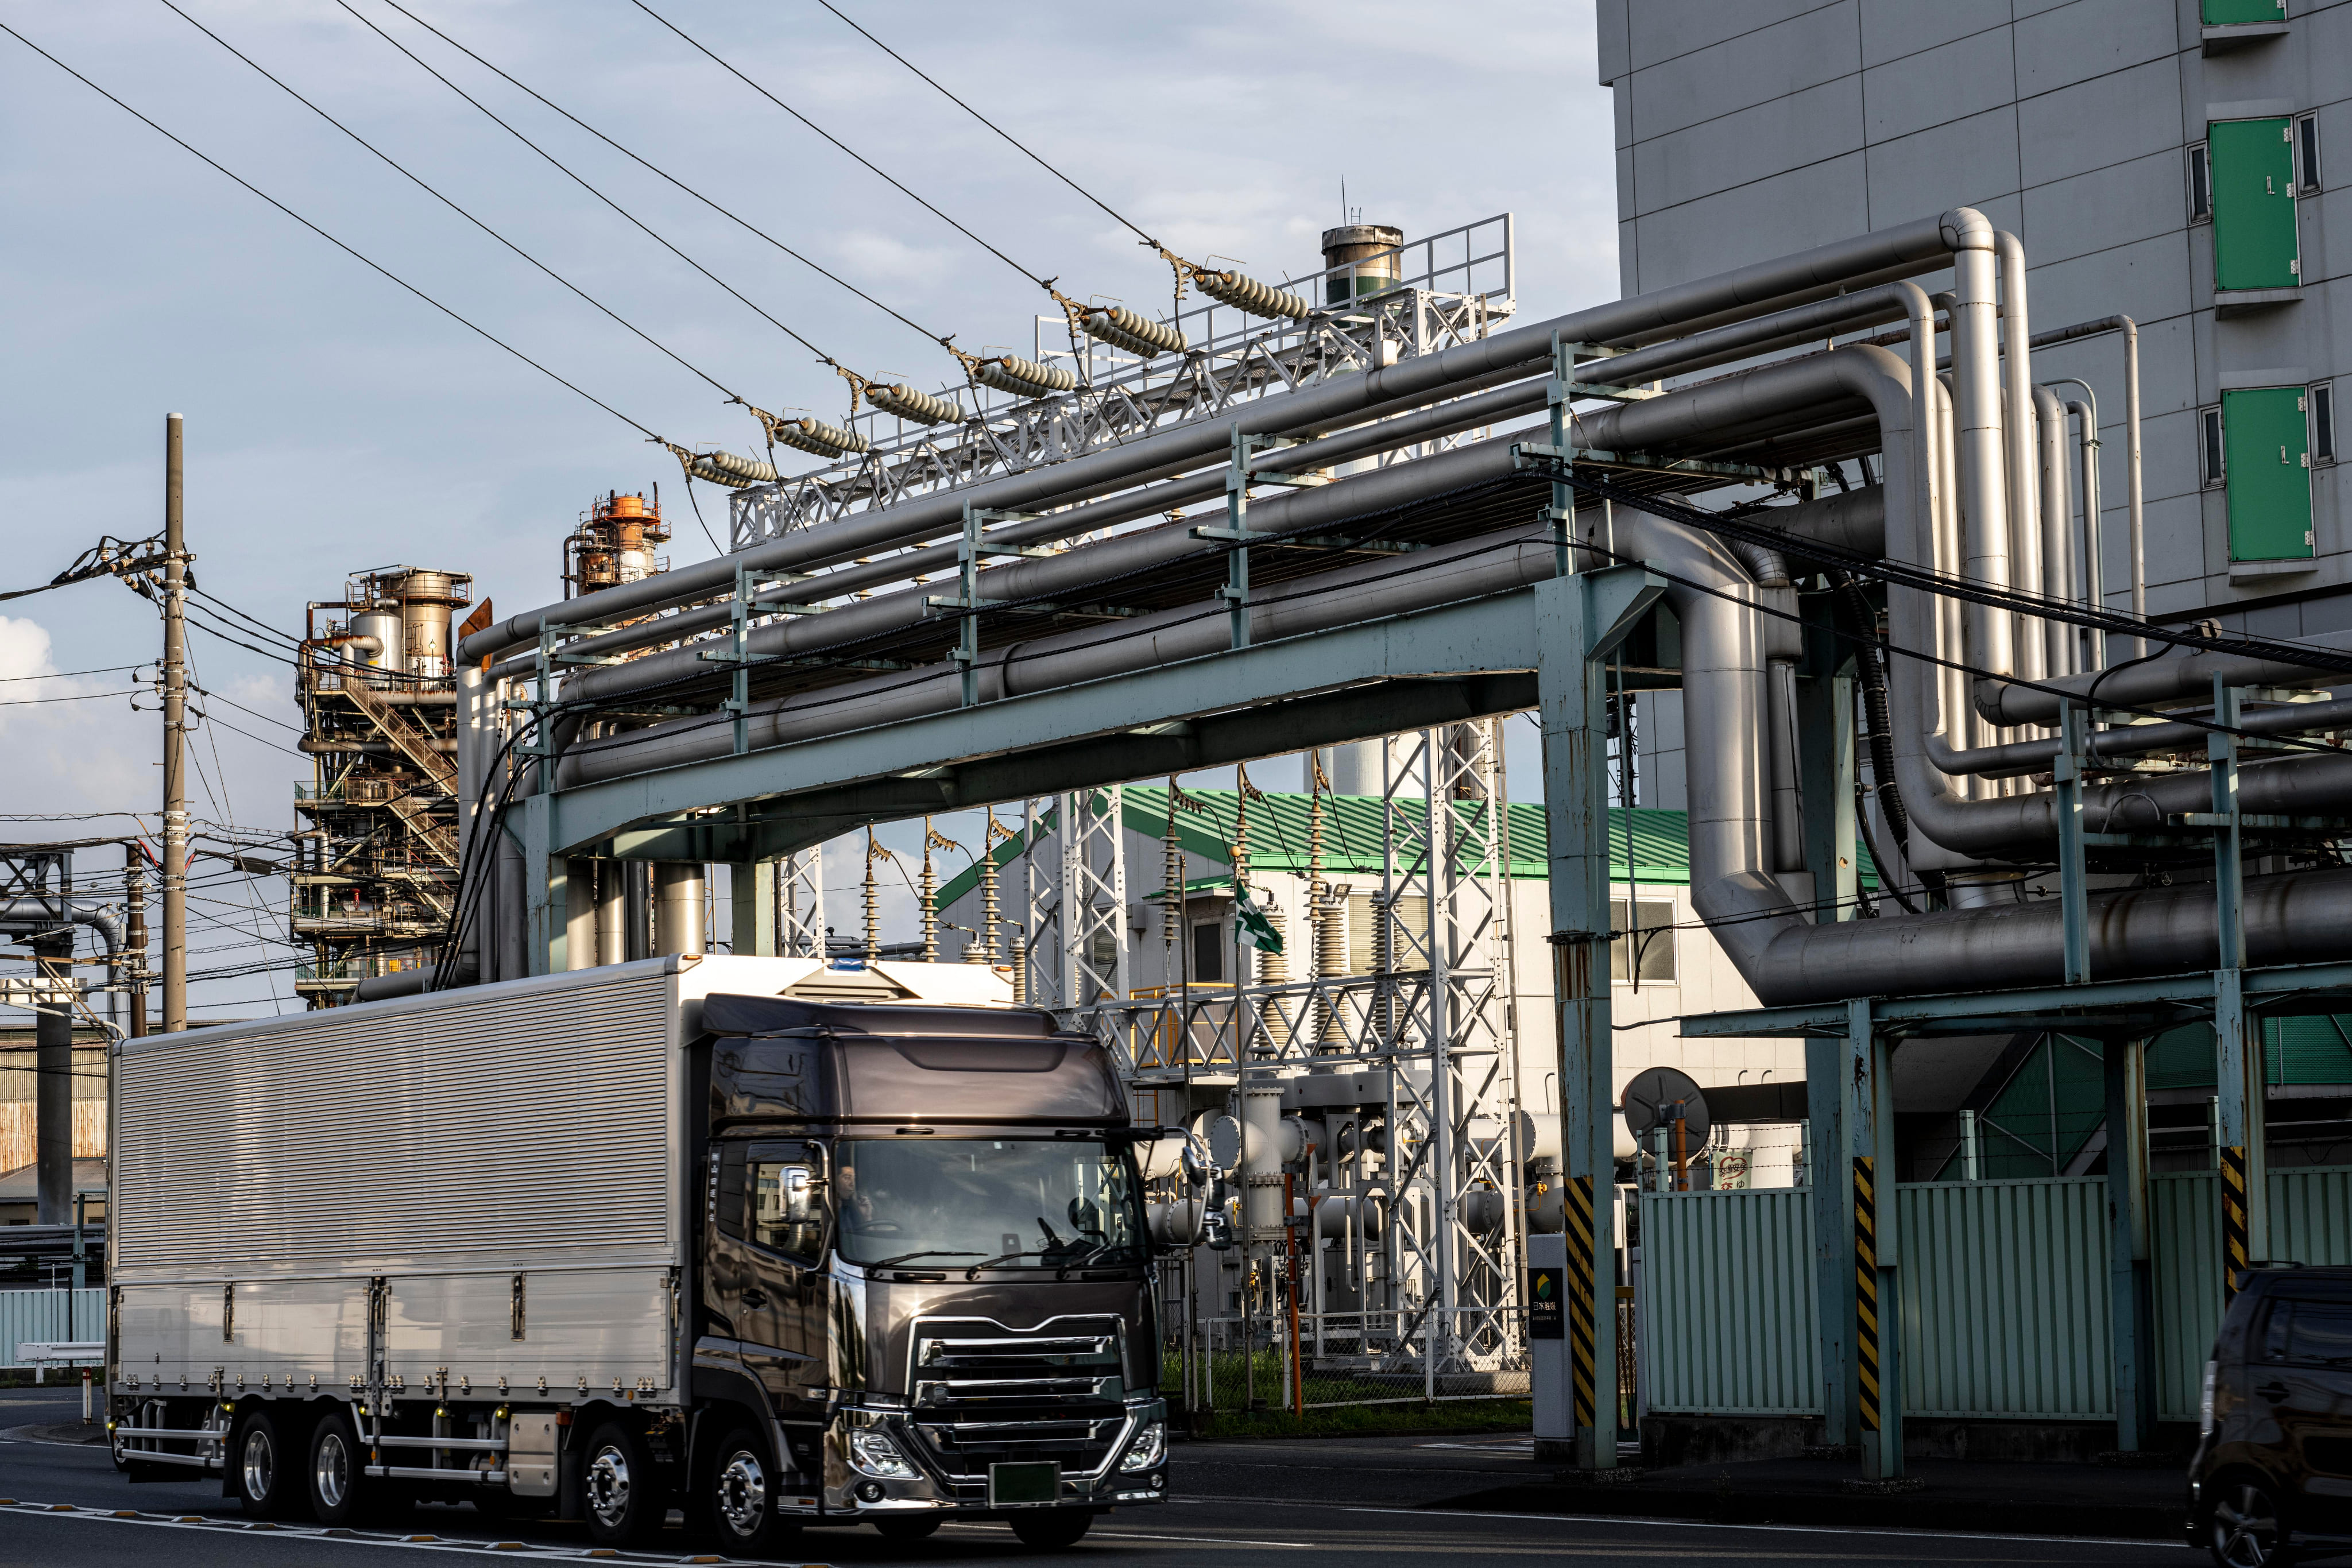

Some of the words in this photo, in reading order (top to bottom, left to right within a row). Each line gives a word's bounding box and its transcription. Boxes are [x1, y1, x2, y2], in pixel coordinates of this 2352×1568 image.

[1719, 1162, 1748, 1176] 交通安全
[1390, 1178, 1394, 1187] 2
[1436, 1175, 1440, 1184] 2
[1736, 1180, 1744, 1188] ゆ
[1533, 1302, 1556, 1310] 日本触媒
